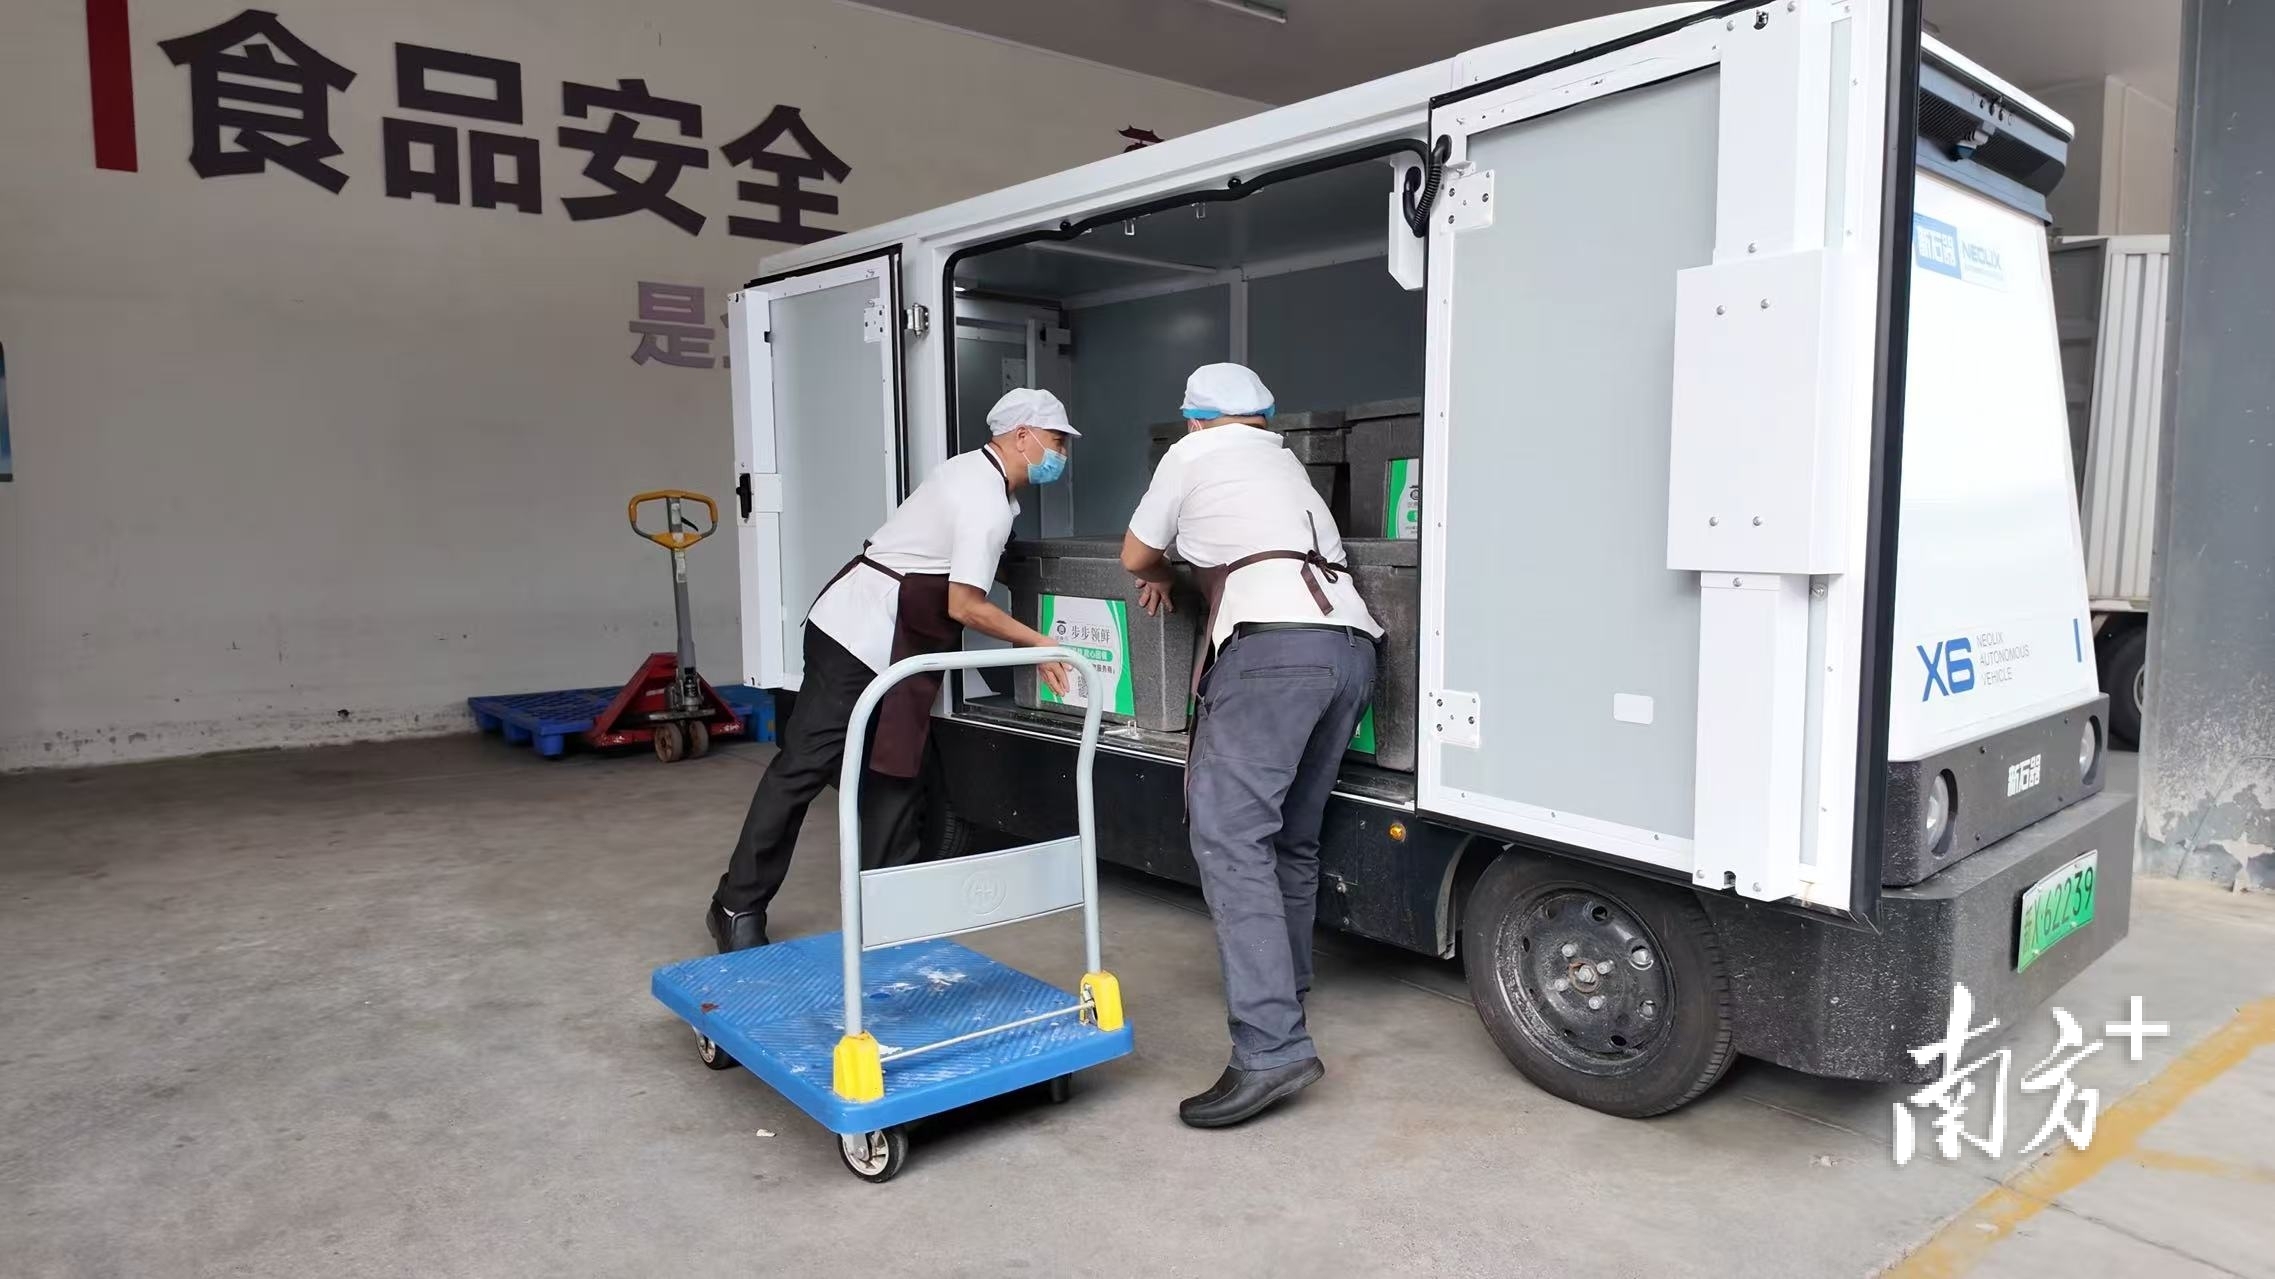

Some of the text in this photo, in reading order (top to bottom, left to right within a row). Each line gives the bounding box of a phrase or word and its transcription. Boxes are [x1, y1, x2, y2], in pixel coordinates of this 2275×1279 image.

[158, 9, 852, 245] 食品安全
[629, 281, 731, 368] 是
[1071, 625, 1111, 643] 步步领鲜
[1976, 631, 2004, 647] NEOLIX
[1916, 637, 1975, 702] X6
[1980, 644, 2031, 666] AUTONOMOUS
[1982, 667, 2013, 685] VEHICLE
[2007, 753, 2041, 797] 新石器
